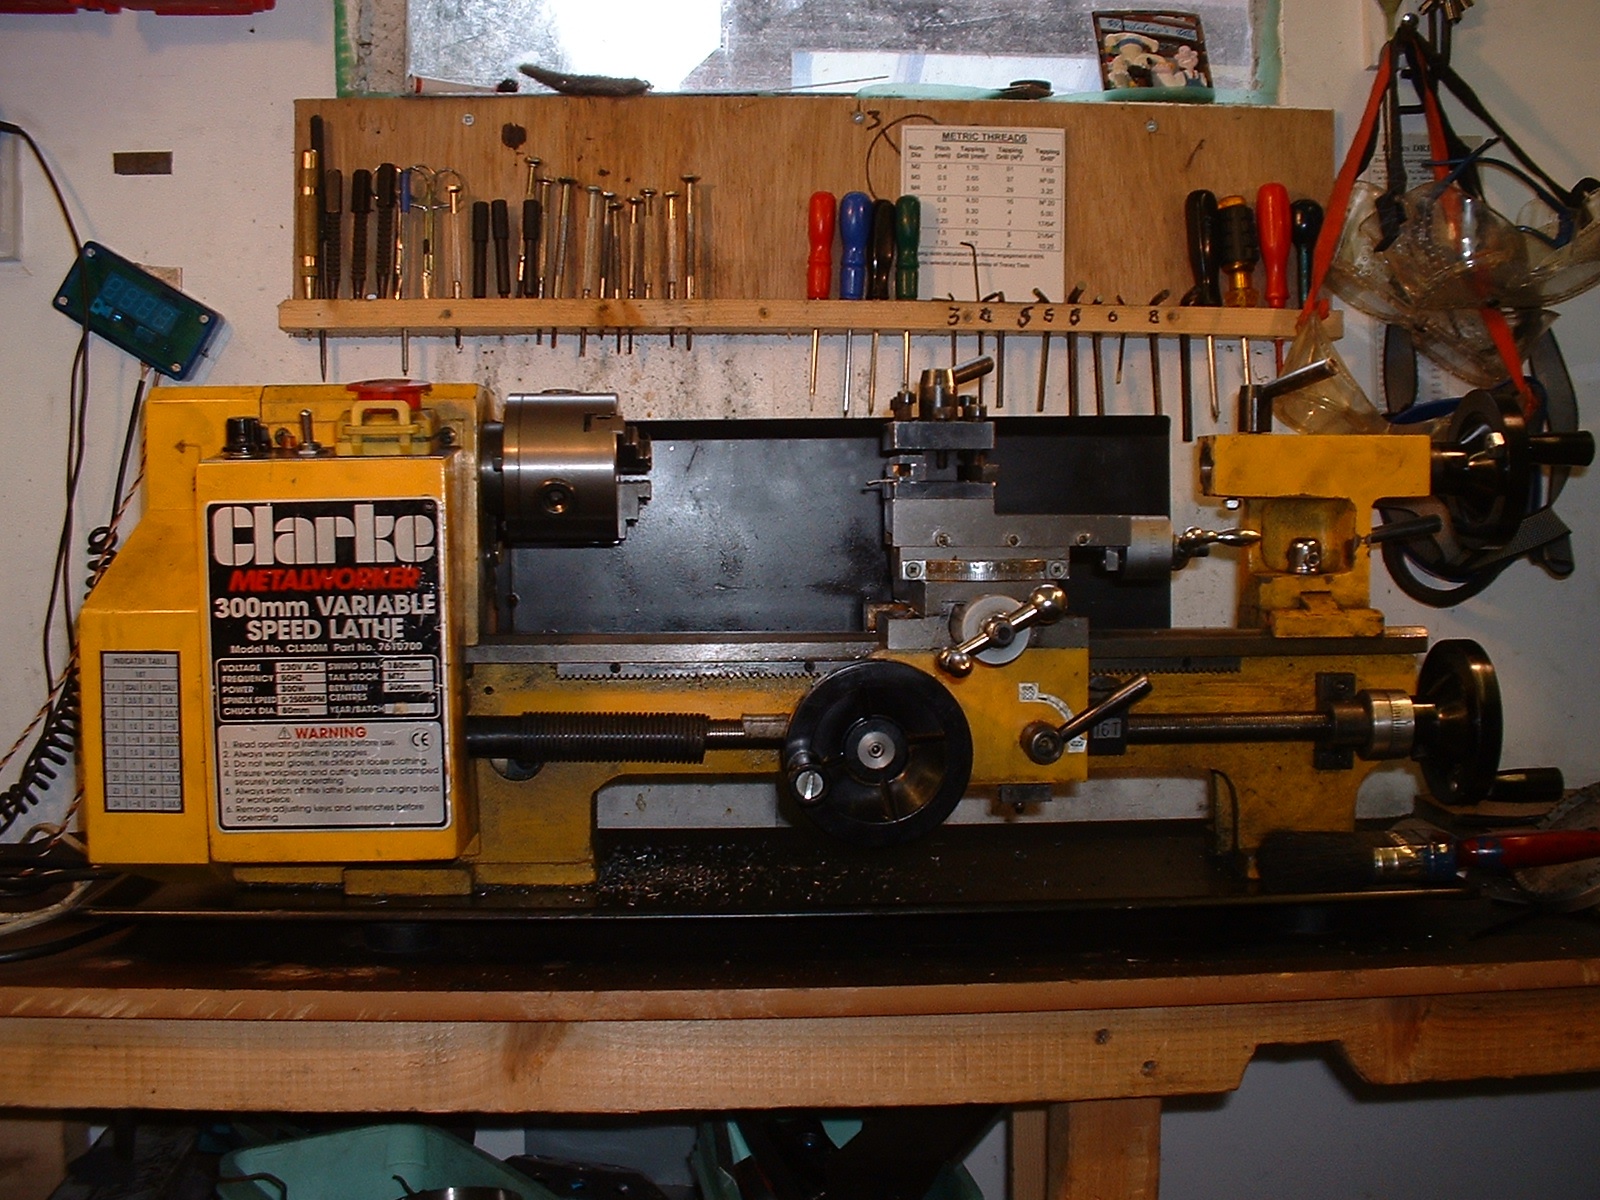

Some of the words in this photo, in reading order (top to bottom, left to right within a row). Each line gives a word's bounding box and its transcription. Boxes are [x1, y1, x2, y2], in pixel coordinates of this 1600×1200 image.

[867, 110, 881, 131] 3
[942, 132, 979, 142] METRIC
[982, 133, 1028, 143] THREADS
[998, 146, 1023, 154] Tapping
[947, 306, 960, 326] 3
[1108, 310, 1118, 322] 6
[1148, 310, 1160, 324] 8
[213, 504, 435, 566] Clarke
[228, 567, 422, 592] METALWORKER
[214, 597, 309, 619] 300mm
[316, 594, 436, 616] VARIABLE
[247, 619, 322, 641] SPEED
[330, 618, 404, 639] LATHE
[230, 645, 264, 654] Model
[265, 644, 284, 653] No.
[286, 644, 328, 653] CL300M
[333, 643, 355, 652] Part
[357, 643, 376, 651] No.
[378, 642, 423, 651] 7610700
[221, 664, 261, 672] VOLTAGE
[280, 663, 303, 671] 230V
[305, 663, 319, 671] AC
[328, 662, 358, 670] SWING
[328, 673, 347, 681] TAIL
[222, 686, 254, 694] POWER
[328, 684, 368, 692] BETWEEN
[222, 696, 253, 704] SPINDLE
[254, 696, 277, 704] SPEED
[329, 693, 368, 702] CENTRES
[223, 707, 256, 715] CHUCK
[330, 705, 385, 713] YEAR/BATCH
[295, 727, 367, 739] WARNING
[411, 732, 429, 747] CE
[258, 741, 299, 749] operating
[301, 740, 348, 748] instructions
[287, 750, 330, 758] protective
[319, 759, 354, 767] neckties
[234, 769, 261, 777] Ensure
[264, 770, 307, 778] workpiece
[329, 768, 359, 777] cutting
[400, 767, 439, 776] clamped
[272, 778, 299, 786] before
[235, 788, 264, 796] Always
[266, 787, 292, 795] switch
[322, 786, 344, 794] lathe
[345, 786, 374, 794] before
[376, 785, 418, 794] changing
[420, 785, 440, 793] tools
[236, 805, 271, 813] Remove
[272, 805, 311, 814] adjusting
[313, 805, 333, 813] keys
[354, 804, 394, 812] wrenches
[396, 803, 424, 811] before
